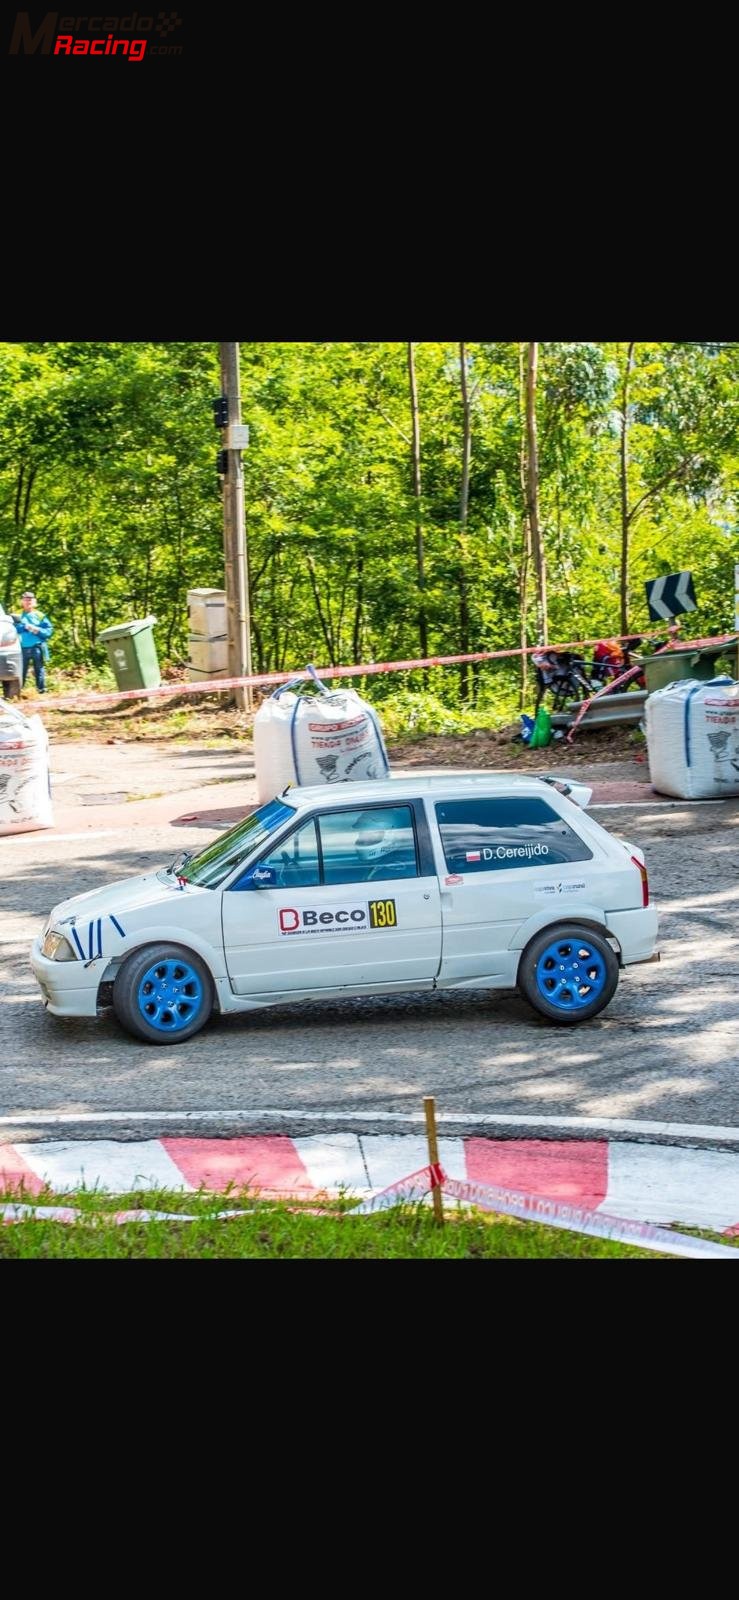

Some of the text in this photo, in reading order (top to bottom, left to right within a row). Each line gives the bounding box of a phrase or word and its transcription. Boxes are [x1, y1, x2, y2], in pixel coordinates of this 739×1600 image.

[483, 843, 549, 861] D.Cereijido
[303, 909, 366, 926] Beco
[370, 900, 395, 927] 130
